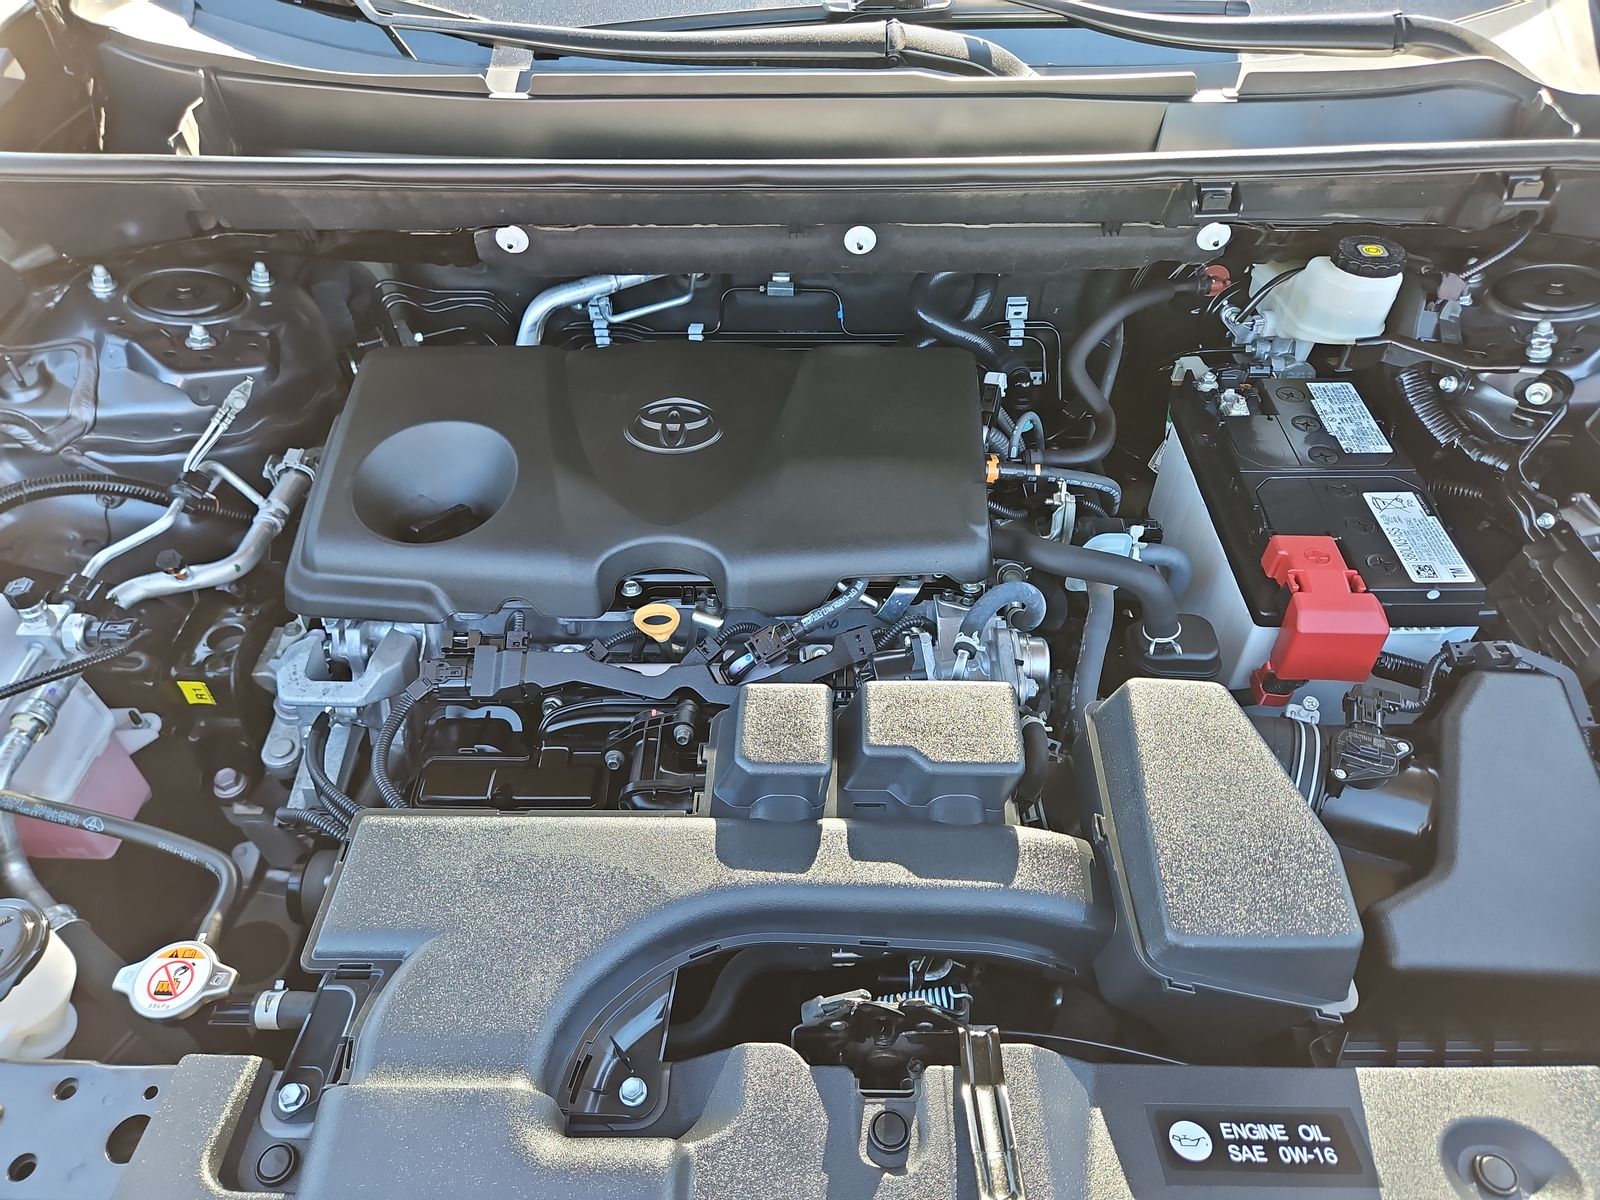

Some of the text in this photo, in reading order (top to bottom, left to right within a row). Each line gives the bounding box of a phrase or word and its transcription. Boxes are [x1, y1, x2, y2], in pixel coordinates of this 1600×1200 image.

[1219, 1122, 1331, 1142] ENGINE OIL
[1228, 1145, 1338, 1165] SAE 0W-16
